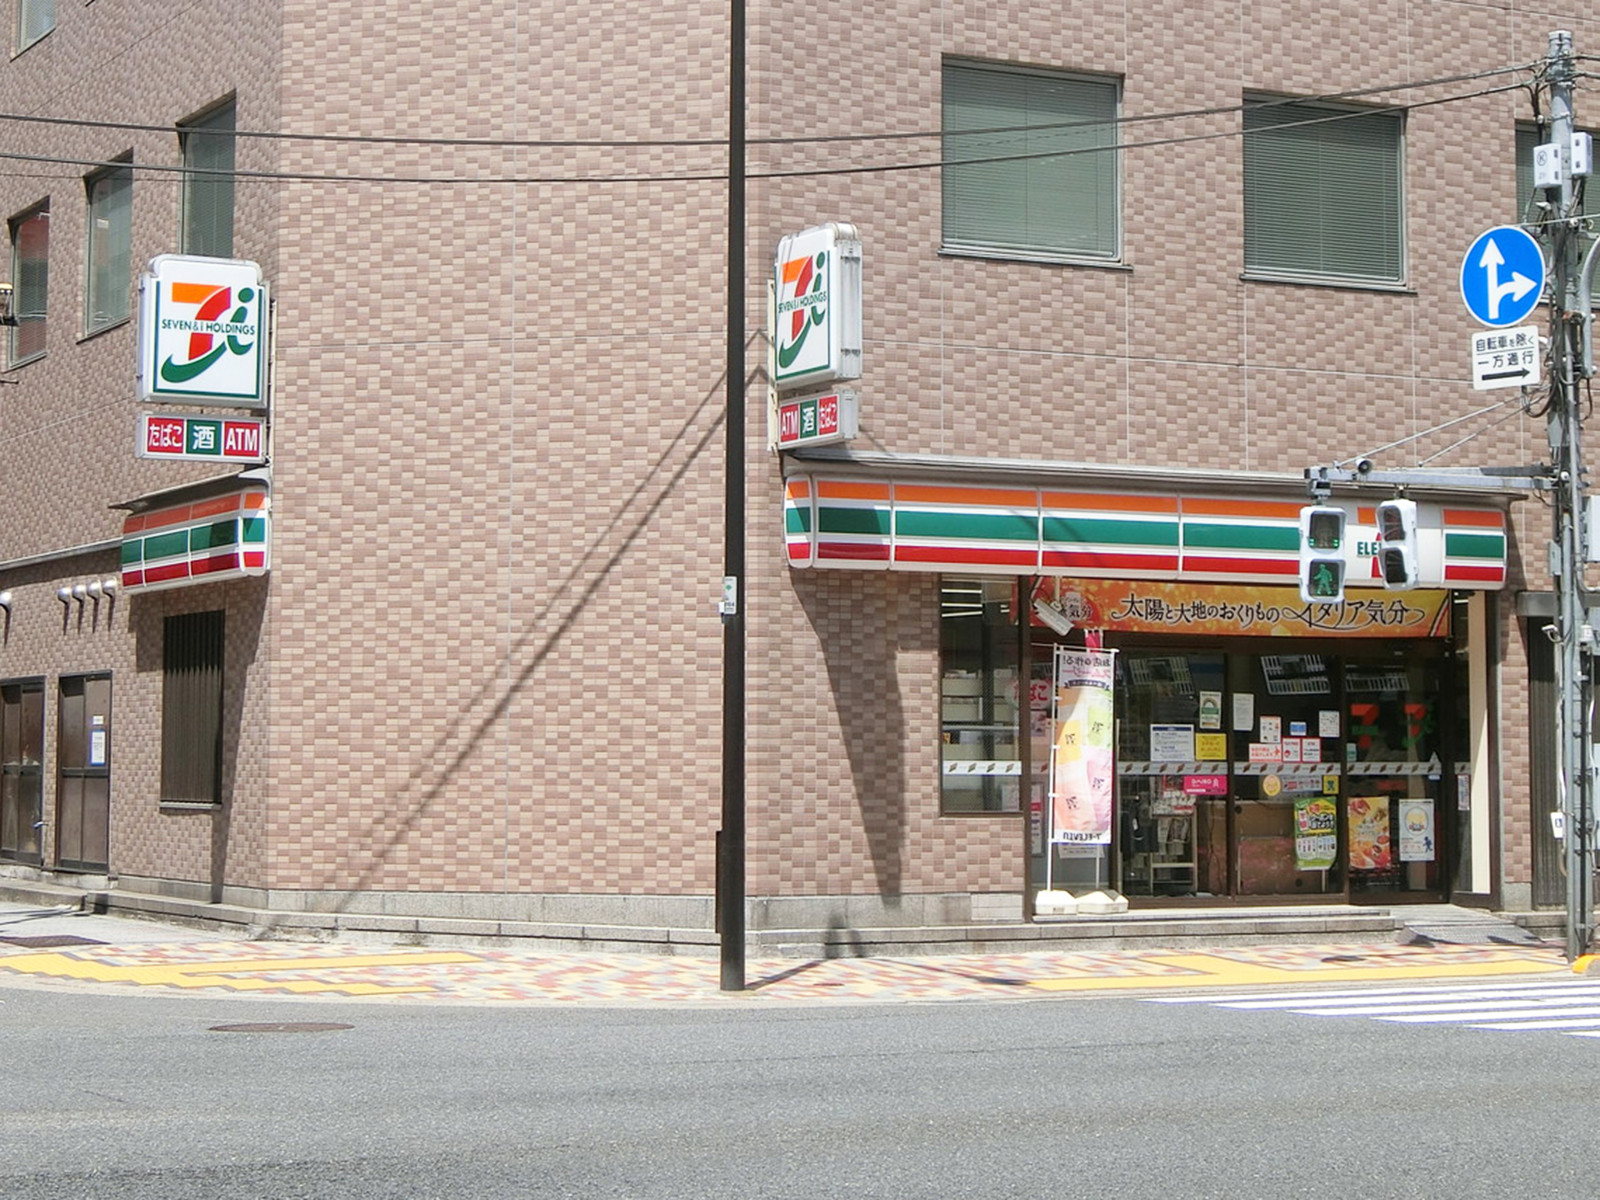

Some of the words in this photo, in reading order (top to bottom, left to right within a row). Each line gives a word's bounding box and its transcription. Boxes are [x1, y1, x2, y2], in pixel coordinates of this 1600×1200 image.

[800, 291, 827, 306] HOLDINGS
[206, 321, 256, 335] HOLDINGS
[1476, 333, 1534, 351] 自転車を除く
[1478, 351, 1533, 368] 一方通行
[781, 412, 798, 435] ATM
[802, 406, 815, 434] 酒
[819, 403, 837, 428] たばこ
[149, 424, 183, 447] たばこ
[193, 425, 216, 450] 酒
[226, 428, 257, 451] ATM
